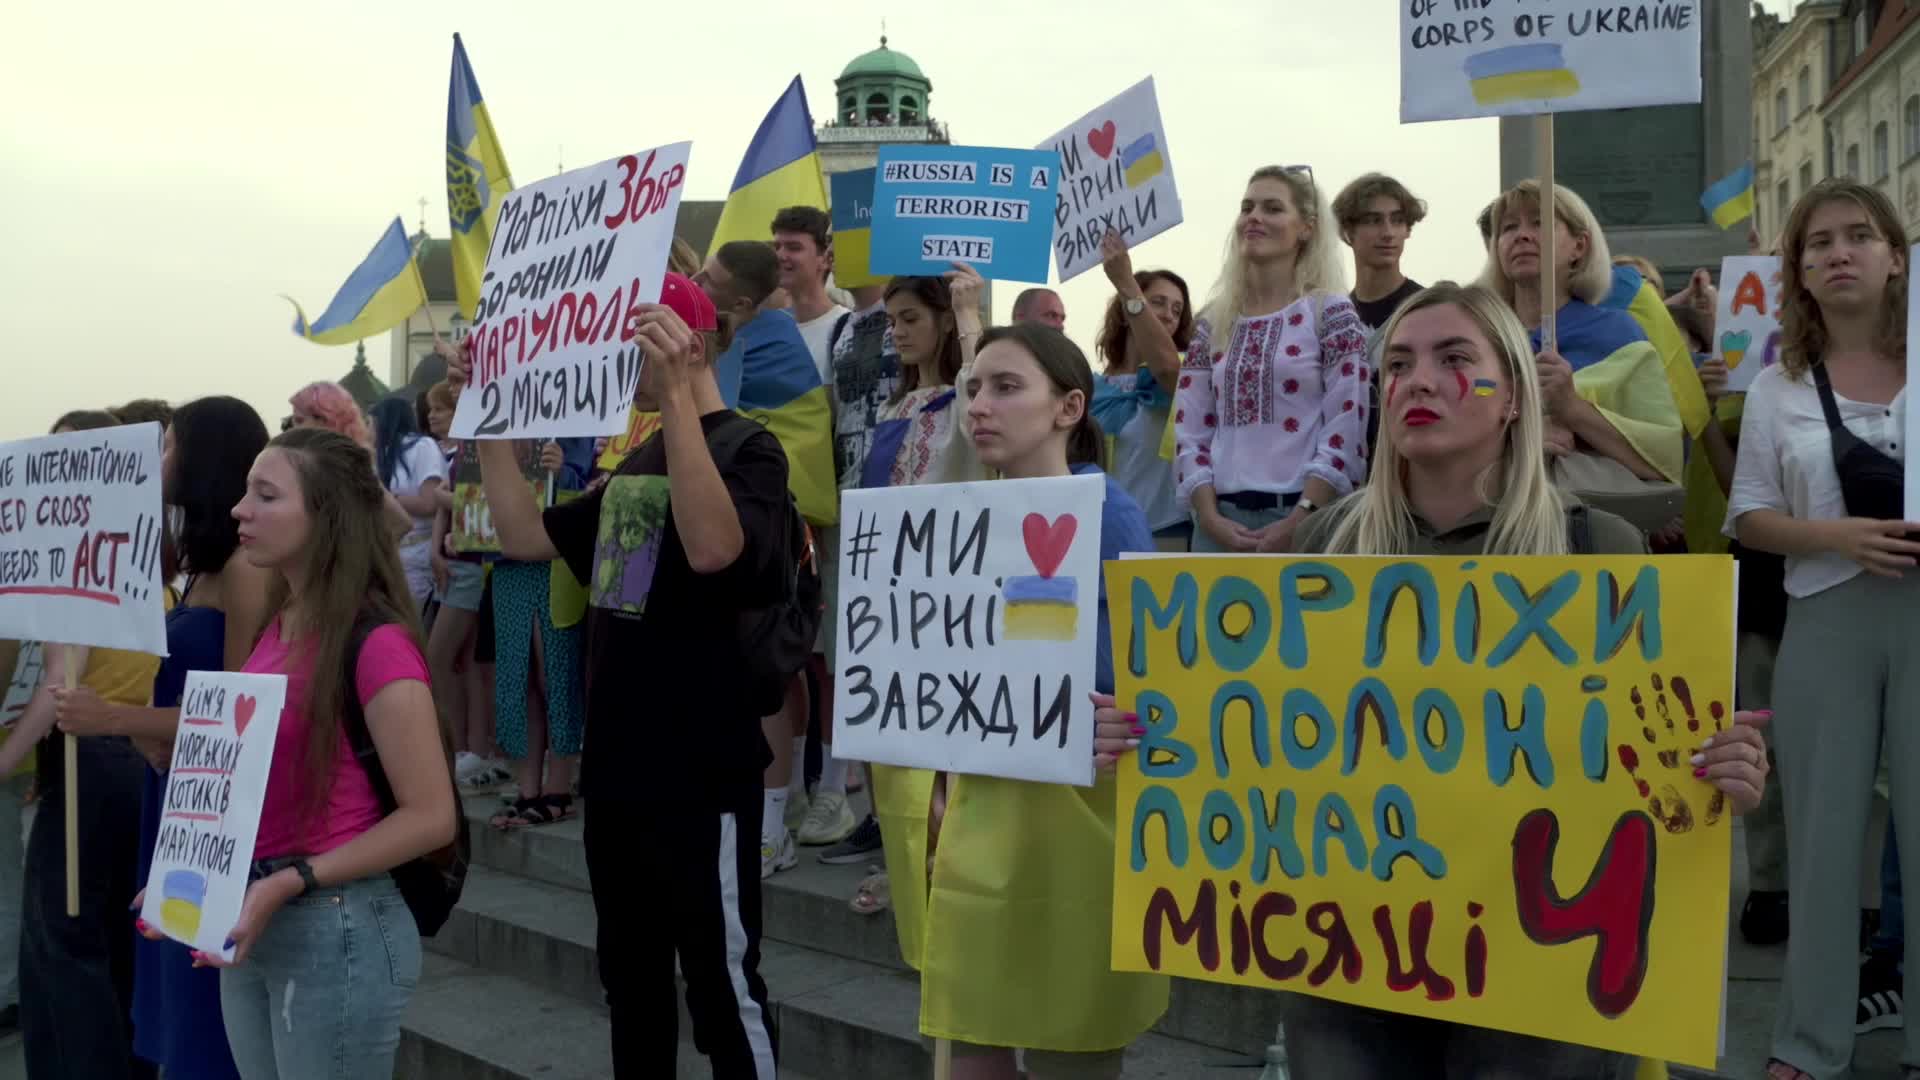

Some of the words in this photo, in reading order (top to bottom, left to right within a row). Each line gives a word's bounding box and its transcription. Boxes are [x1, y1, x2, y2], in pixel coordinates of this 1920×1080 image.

[1412, 16, 1495, 49] CORPS
[1514, 14, 1554, 37] OF
[1568, 5, 1692, 36] UKRAINE
[885, 163, 975, 183] #RUSSIA
[991, 165, 1013, 185] IS
[1031, 169, 1049, 188] A
[1055, 147, 1123, 229] ВІРНІ
[896, 197, 1029, 221] TERRORIST
[921, 239, 992, 261] STATE
[474, 382, 509, 437] 2
[0, 498, 27, 536] ED
[36, 494, 92, 528] CROSS
[48, 546, 66, 584] TO
[846, 577, 1003, 655] ВІРНІ
[1128, 560, 1662, 677] МОРПІХИ
[845, 664, 1072, 749] ЗАВЖДИ
[168, 774, 232, 815] КОТИКІВ
[155, 820, 238, 877] МАРІУПОЛЯ
[1130, 783, 1448, 884] ПОНАД
[1143, 878, 1488, 1001] МІСЯЦІ
